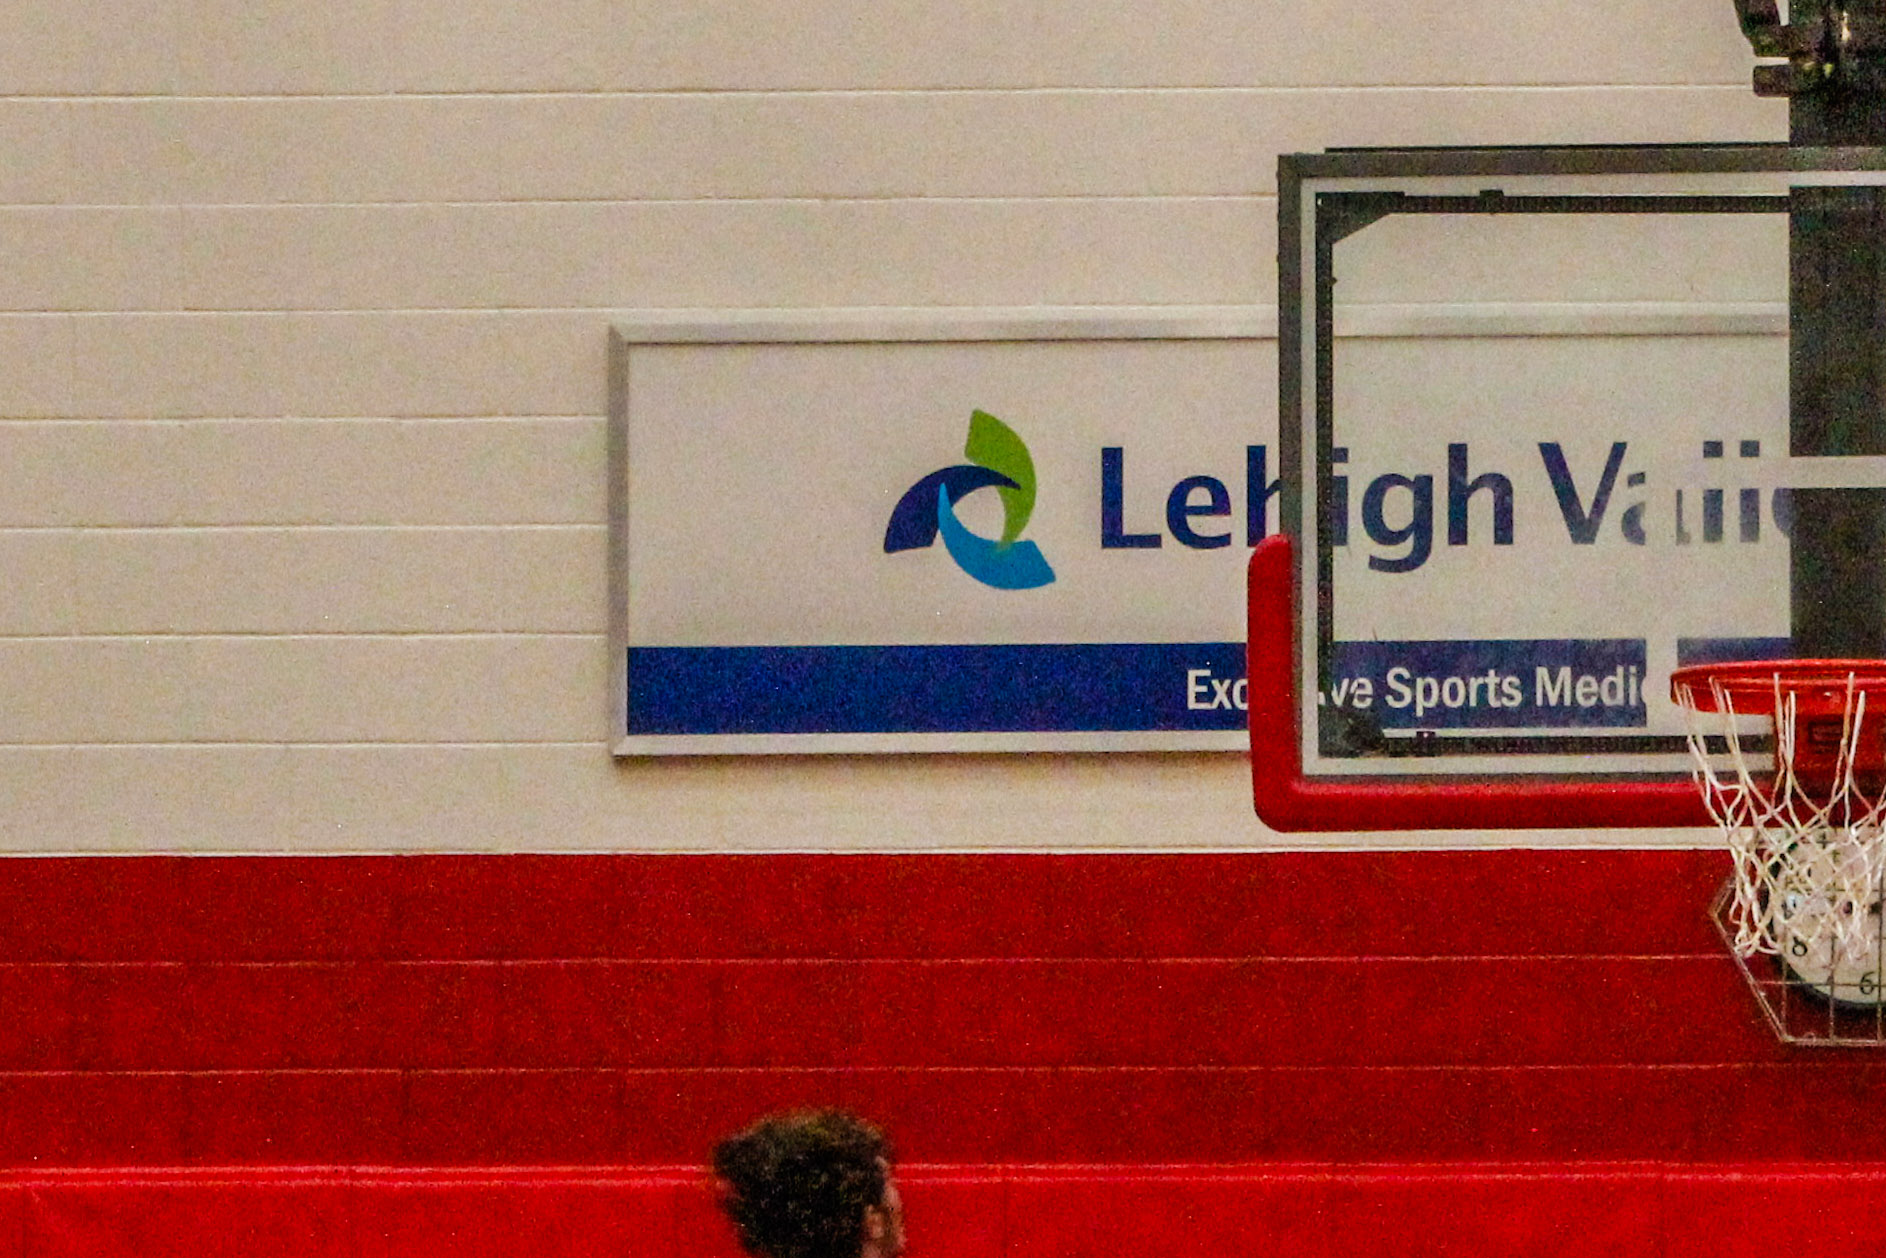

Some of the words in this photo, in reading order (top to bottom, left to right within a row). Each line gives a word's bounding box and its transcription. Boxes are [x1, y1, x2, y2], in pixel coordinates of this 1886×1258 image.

[1101, 443, 1514, 573] Lehigh
[1187, 668, 1373, 710] Excve
[1385, 666, 1523, 717] Sports
[1536, 664, 1646, 707] Medi
[1859, 970, 1876, 996] 6
